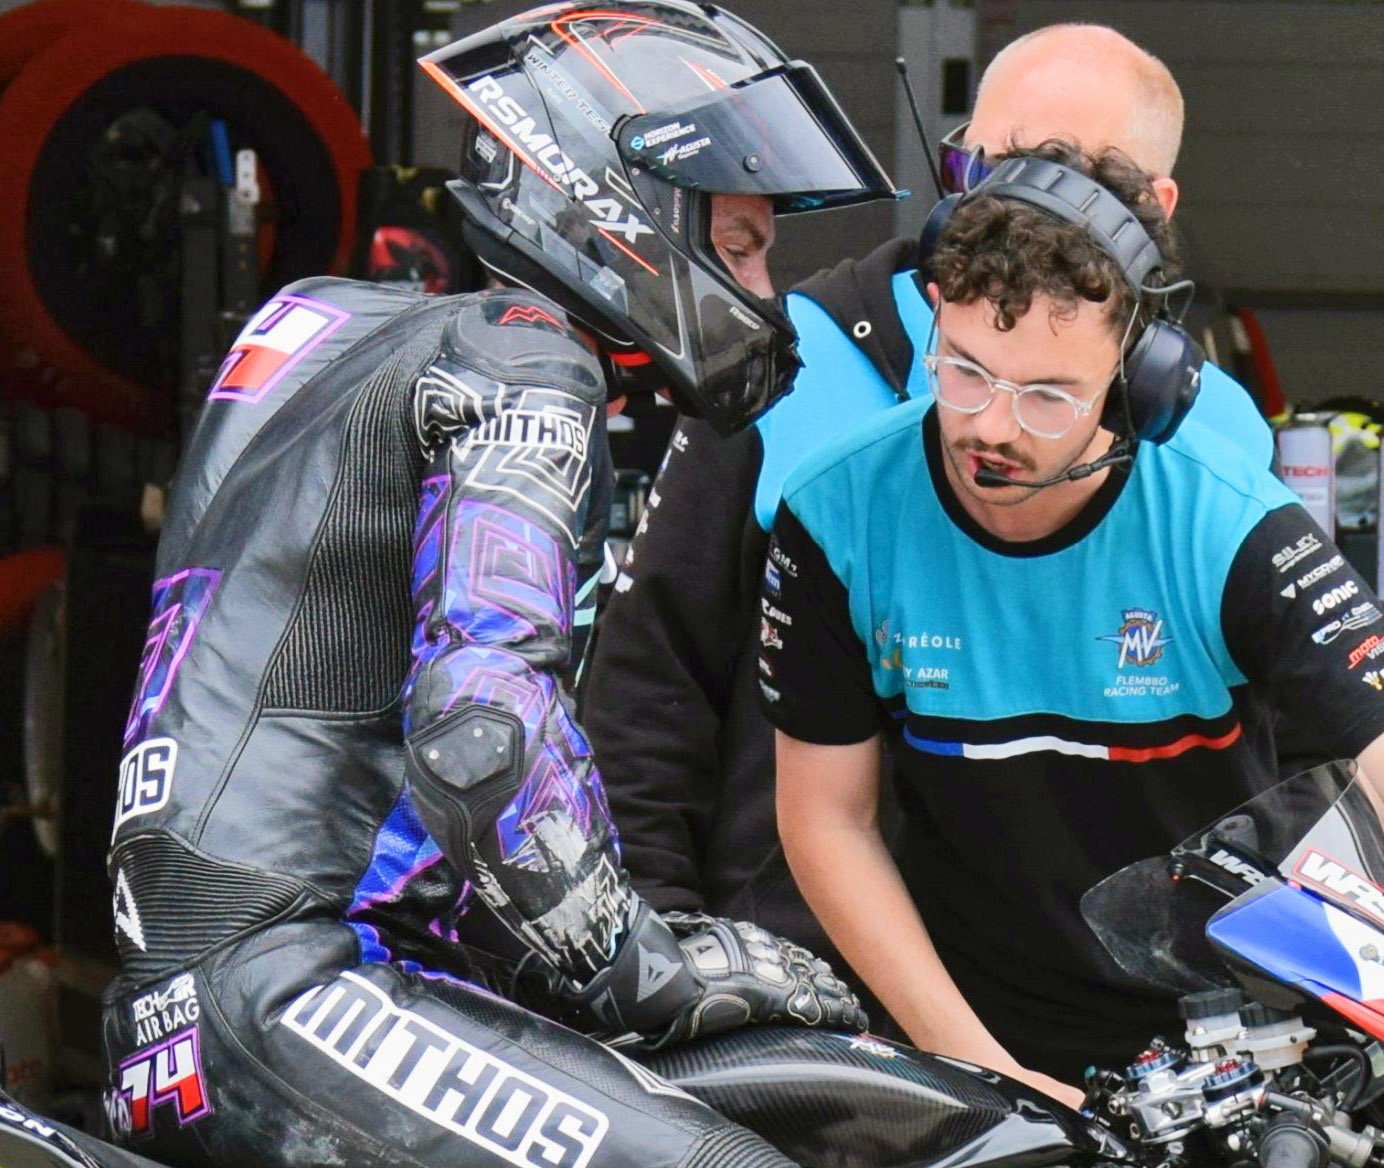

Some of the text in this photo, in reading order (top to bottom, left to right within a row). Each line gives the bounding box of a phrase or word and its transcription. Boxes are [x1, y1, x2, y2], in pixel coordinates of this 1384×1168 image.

[527, 53, 576, 101] WINTER
[468, 75, 656, 245] RSMORAX
[893, 632, 962, 650] ZRÉOLE
[1118, 619, 1164, 669] MV
[917, 667, 950, 680] AZAR
[1103, 683, 1180, 697] RACING TEAM
